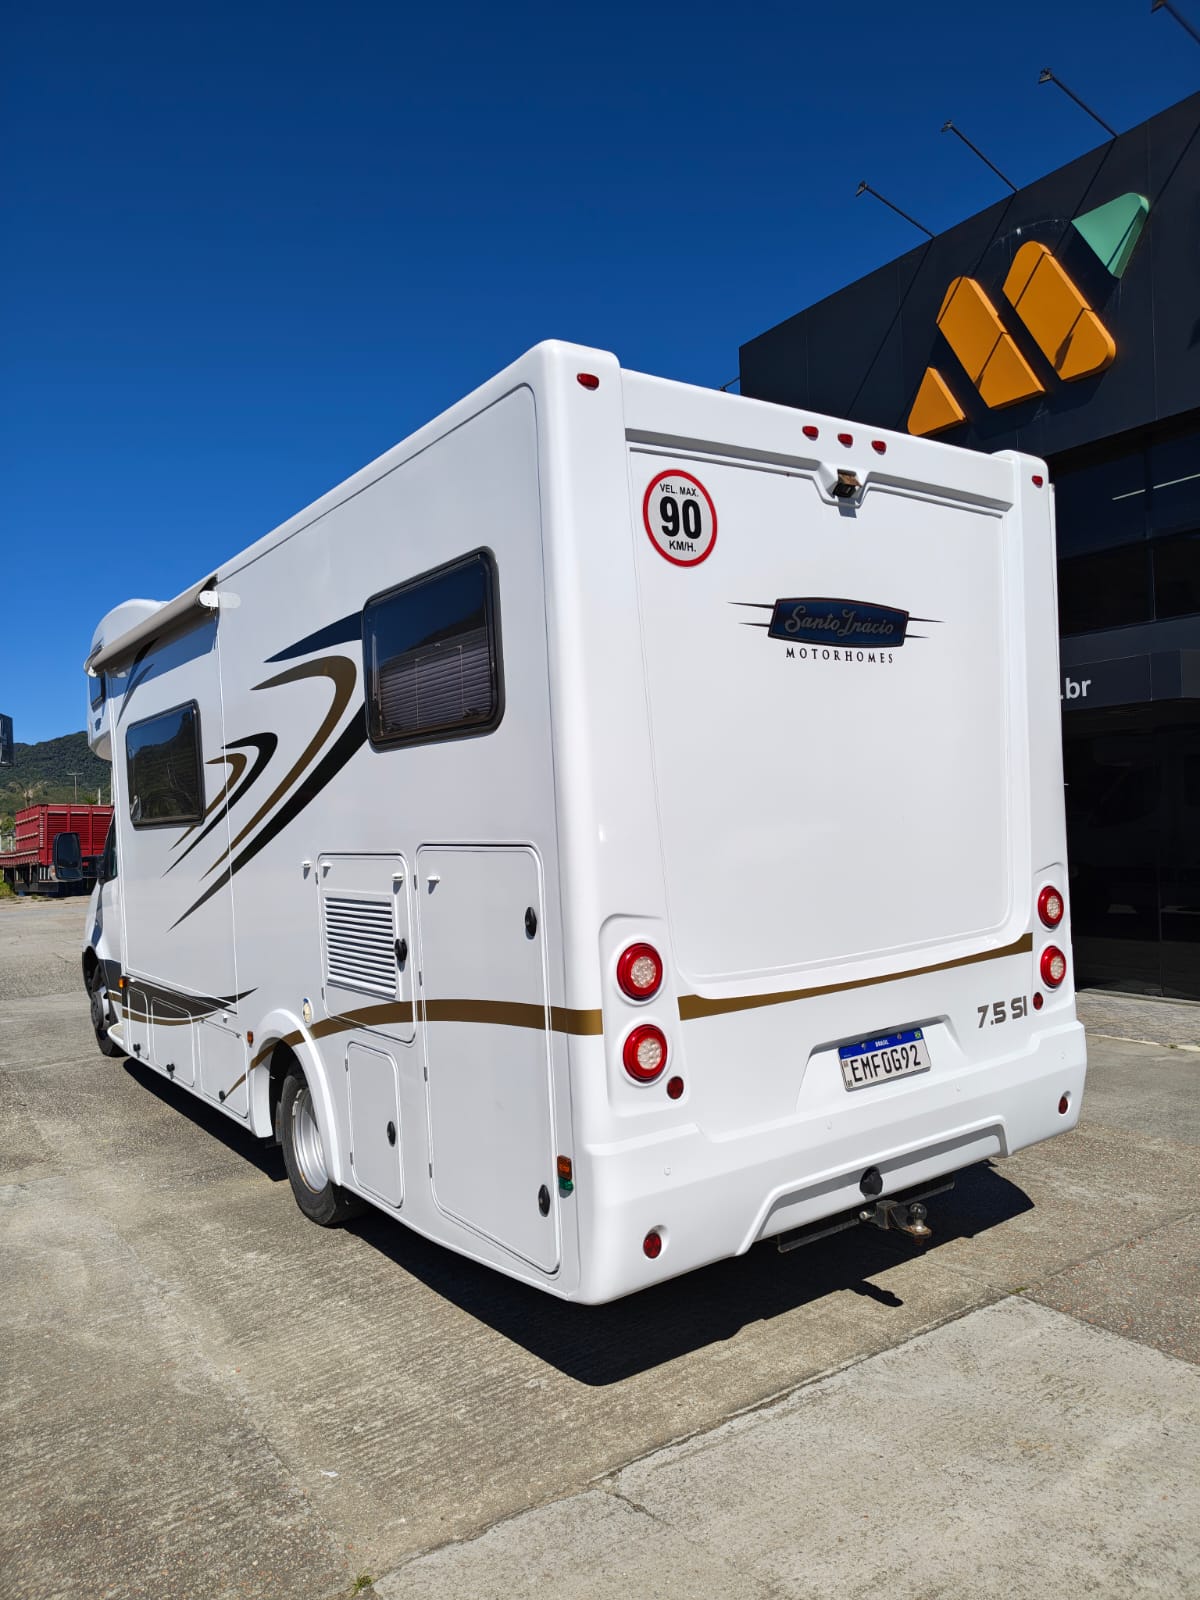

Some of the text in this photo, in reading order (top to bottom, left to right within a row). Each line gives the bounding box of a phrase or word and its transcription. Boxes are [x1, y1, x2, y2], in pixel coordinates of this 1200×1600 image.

[659, 483, 699, 497] VEL. MAX.
[659, 496, 702, 540] 90
[668, 540, 697, 553] KM/H.
[784, 604, 840, 634] Santo
[786, 647, 894, 664] MOTORHOMES
[977, 995, 1028, 1029] 7.5 SI
